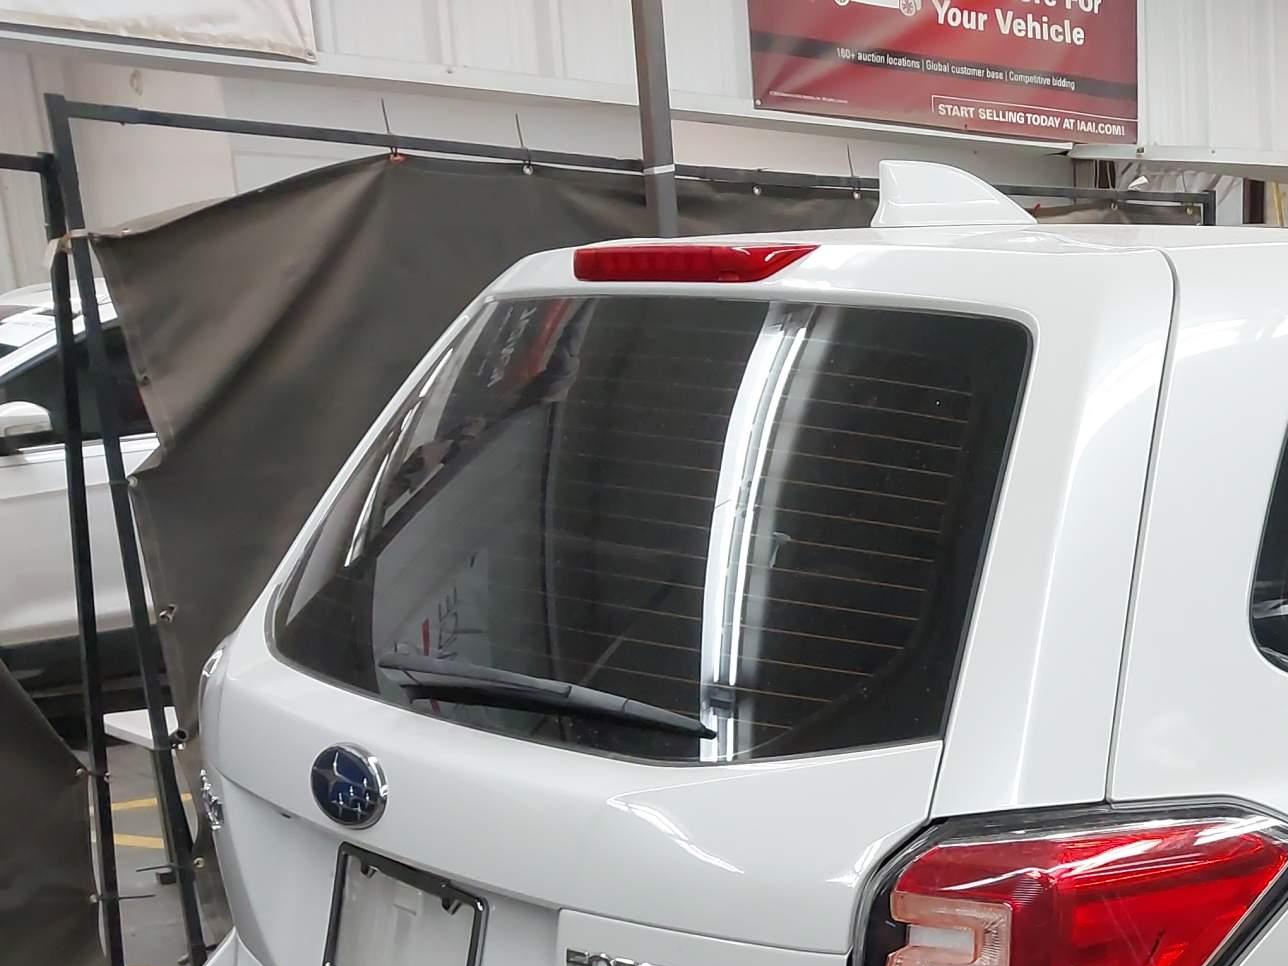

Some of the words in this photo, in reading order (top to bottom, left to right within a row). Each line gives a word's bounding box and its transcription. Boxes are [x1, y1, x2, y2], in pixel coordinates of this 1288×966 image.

[934, 0, 988, 31] Your
[994, 8, 1086, 46] Vehicle
[857, 52, 885, 64] auction
[886, 54, 921, 69] locations
[926, 60, 950, 73] Global
[951, 64, 985, 78] customer
[986, 69, 1004, 80] base
[1008, 71, 1051, 87] Competitive
[1052, 77, 1076, 91] bidding
[938, 103, 975, 118] START
[978, 106, 1025, 124] SELLING
[1026, 112, 1061, 128] TODAY
[1063, 118, 1076, 130] AT
